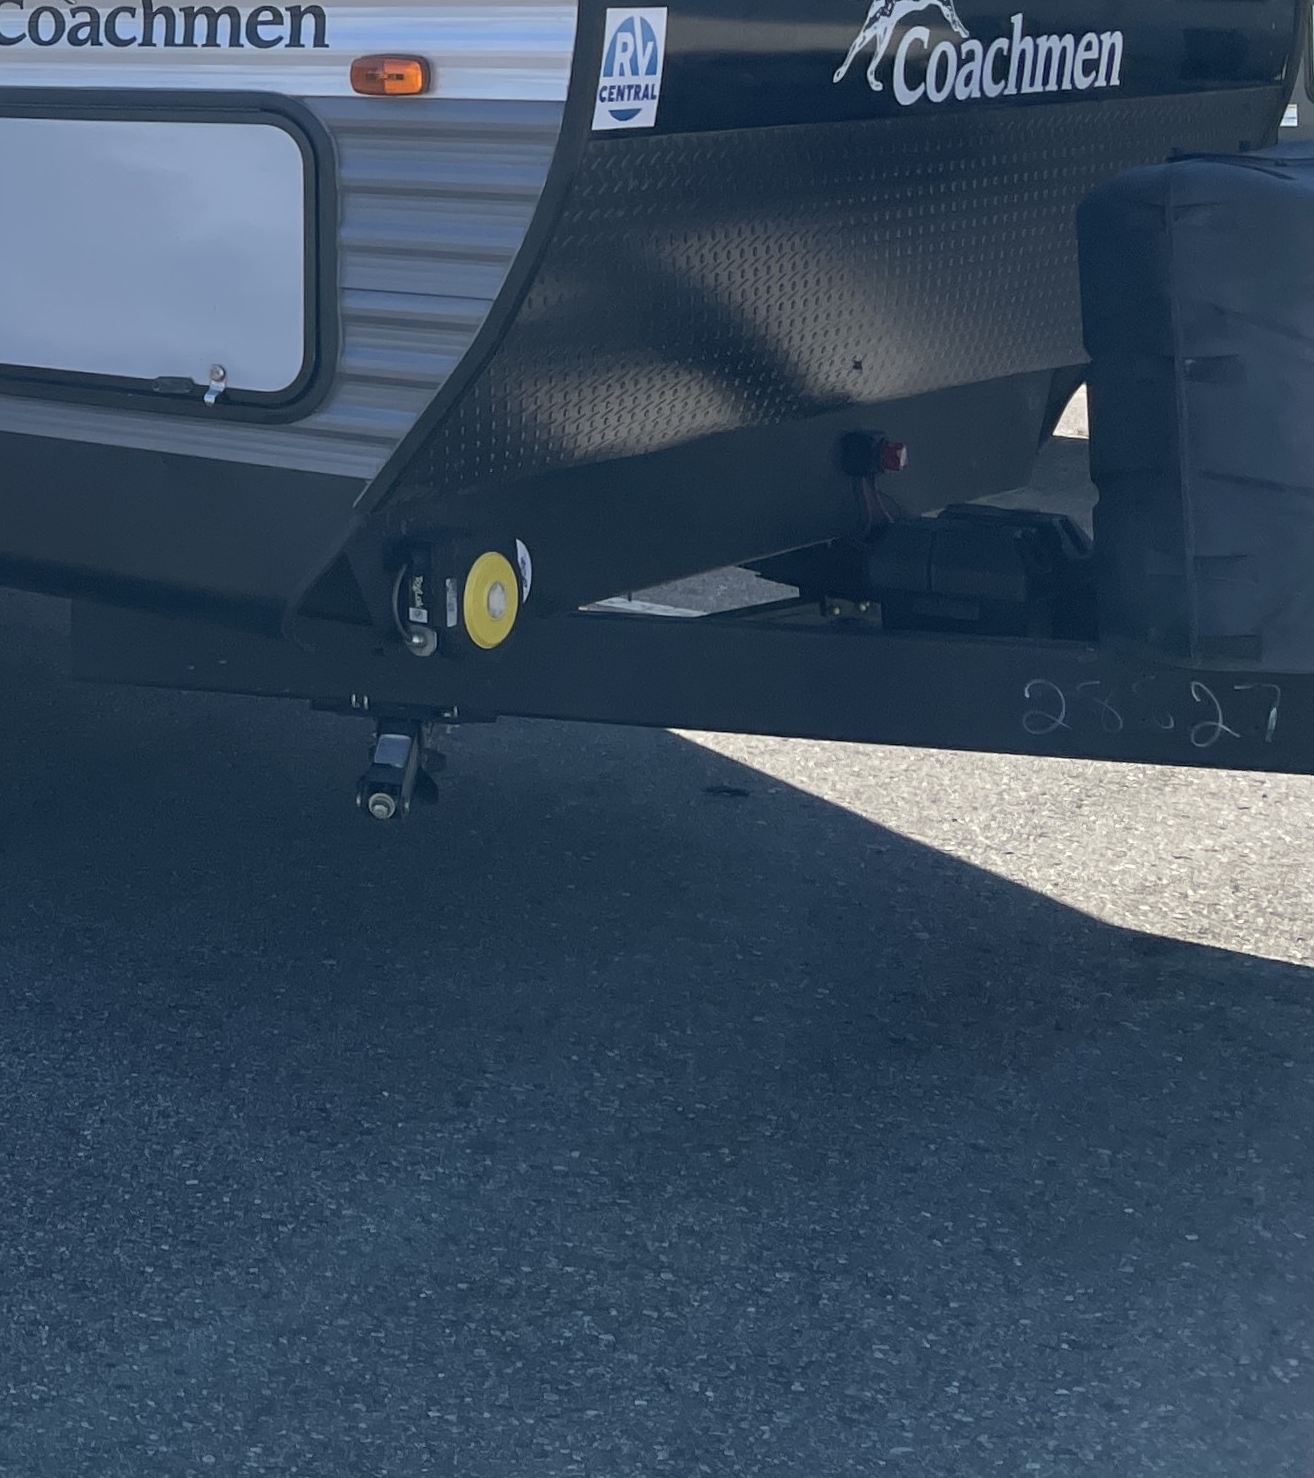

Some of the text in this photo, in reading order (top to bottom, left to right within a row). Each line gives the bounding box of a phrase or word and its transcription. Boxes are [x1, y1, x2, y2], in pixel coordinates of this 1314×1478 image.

[613, 15, 654, 77] RV
[891, 12, 1124, 106] Coachmen
[599, 84, 657, 103] CENTRAL
